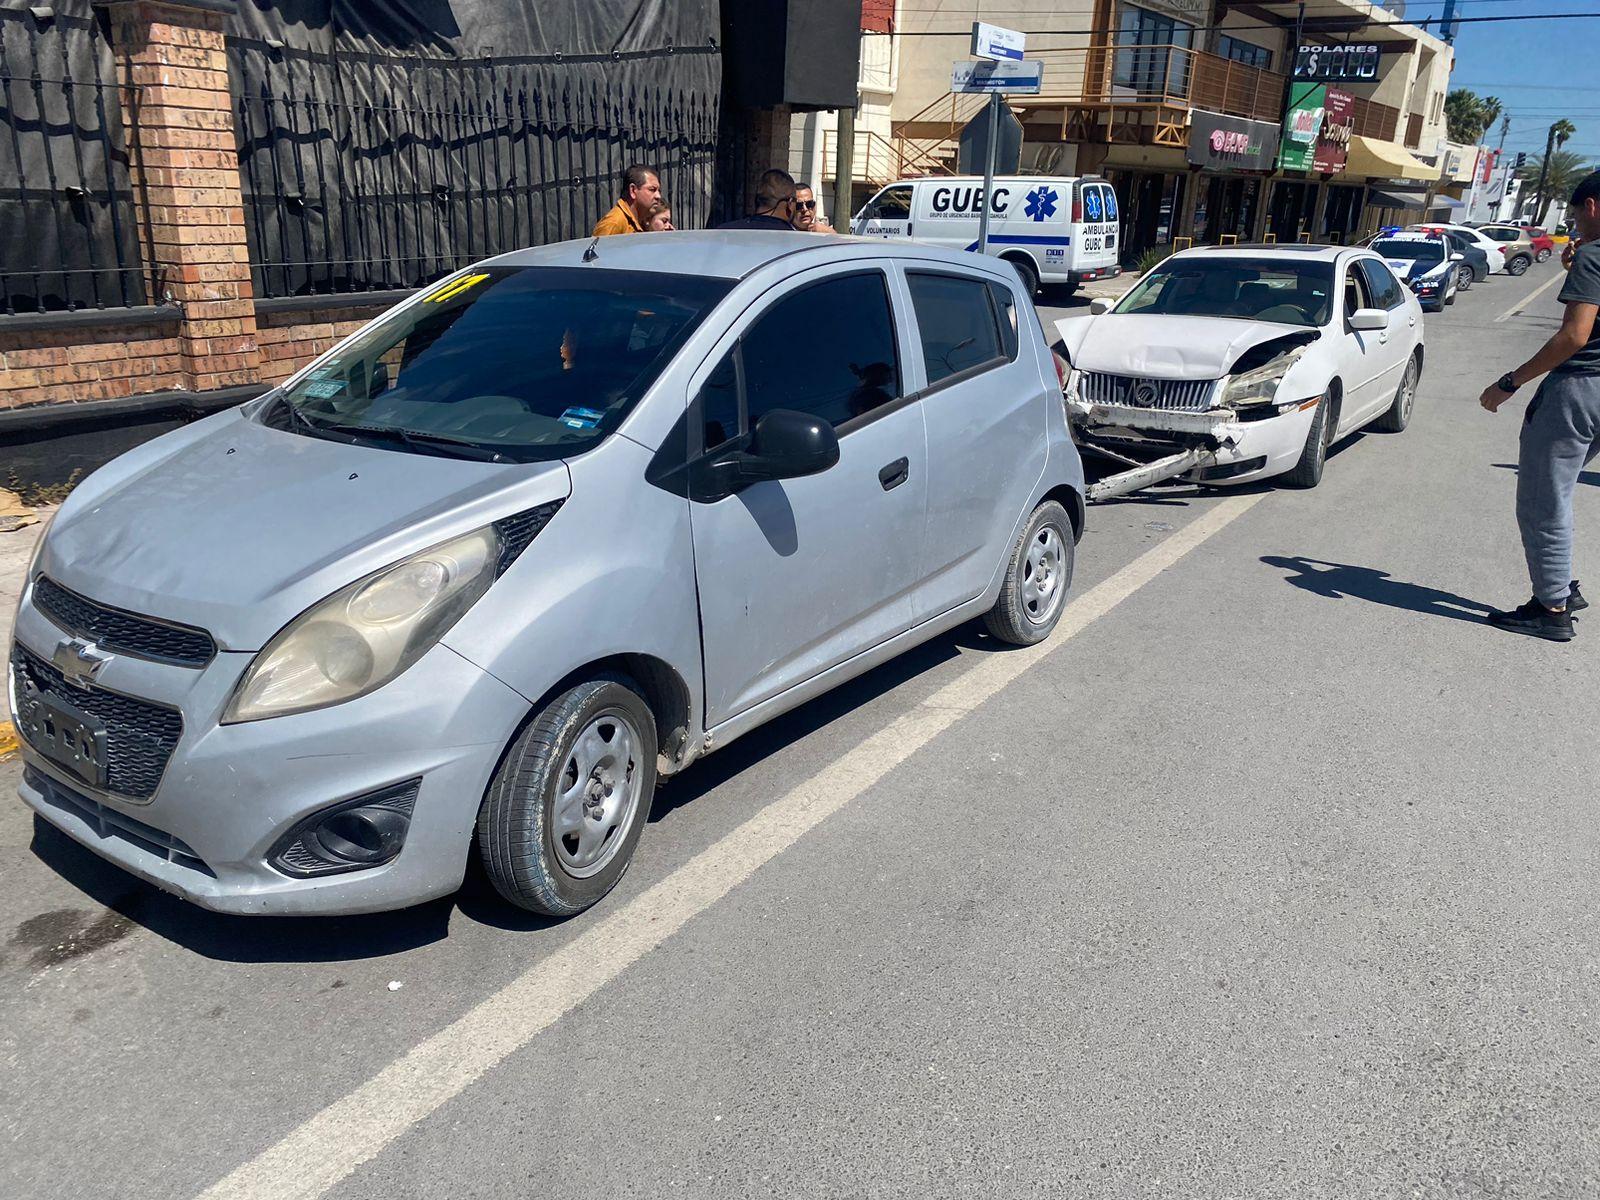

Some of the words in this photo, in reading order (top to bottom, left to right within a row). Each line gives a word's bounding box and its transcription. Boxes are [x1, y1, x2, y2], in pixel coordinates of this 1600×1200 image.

[1298, 45, 1378, 53] DOLARES
[932, 187, 1010, 213] GUBC
[866, 227, 900, 235] VOLUNTARIOS
[1084, 237, 1102, 251] GUBC
